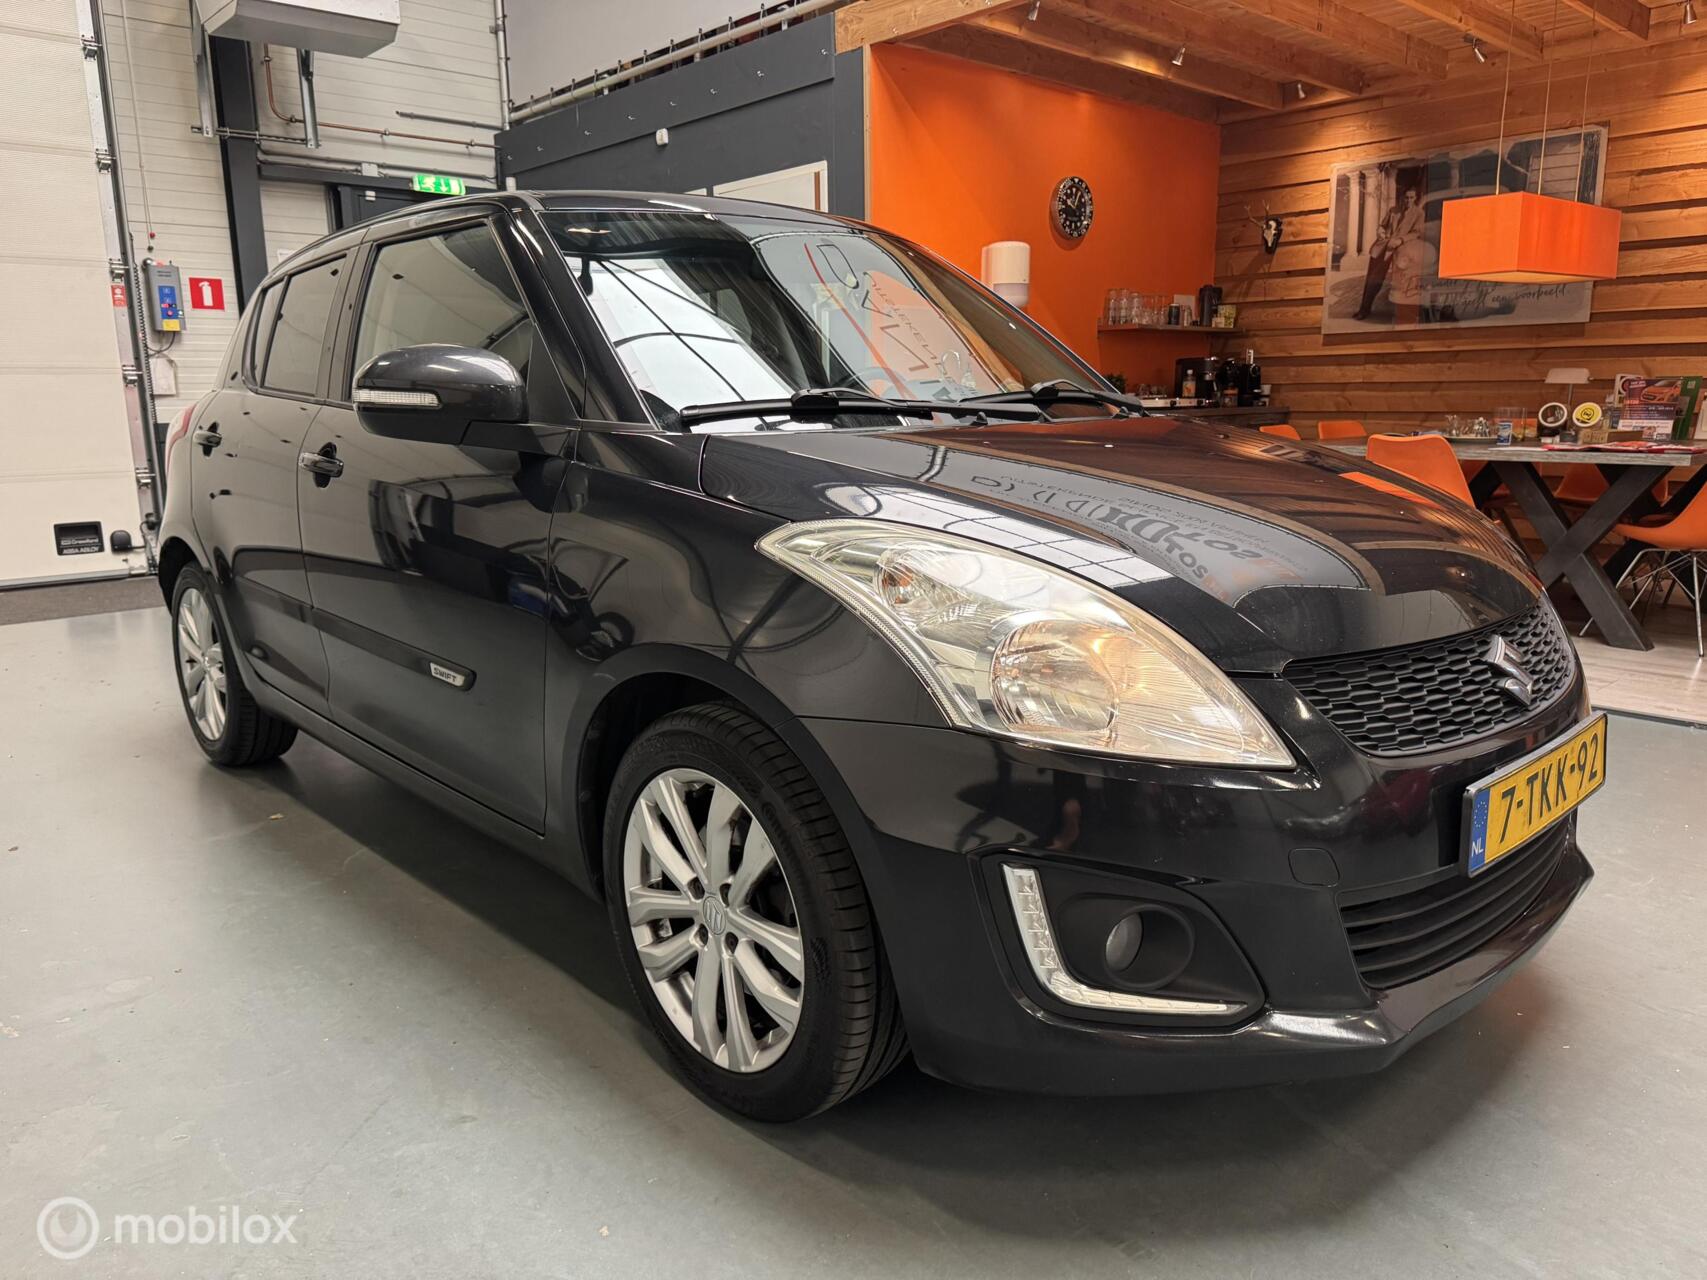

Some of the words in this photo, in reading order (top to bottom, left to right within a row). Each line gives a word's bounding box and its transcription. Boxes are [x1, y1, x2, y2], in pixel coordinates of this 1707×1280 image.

[433, 667, 457, 682] SWIFT
[1500, 732, 1599, 844] 7-TKK-92
[1471, 837, 1484, 857] NL
